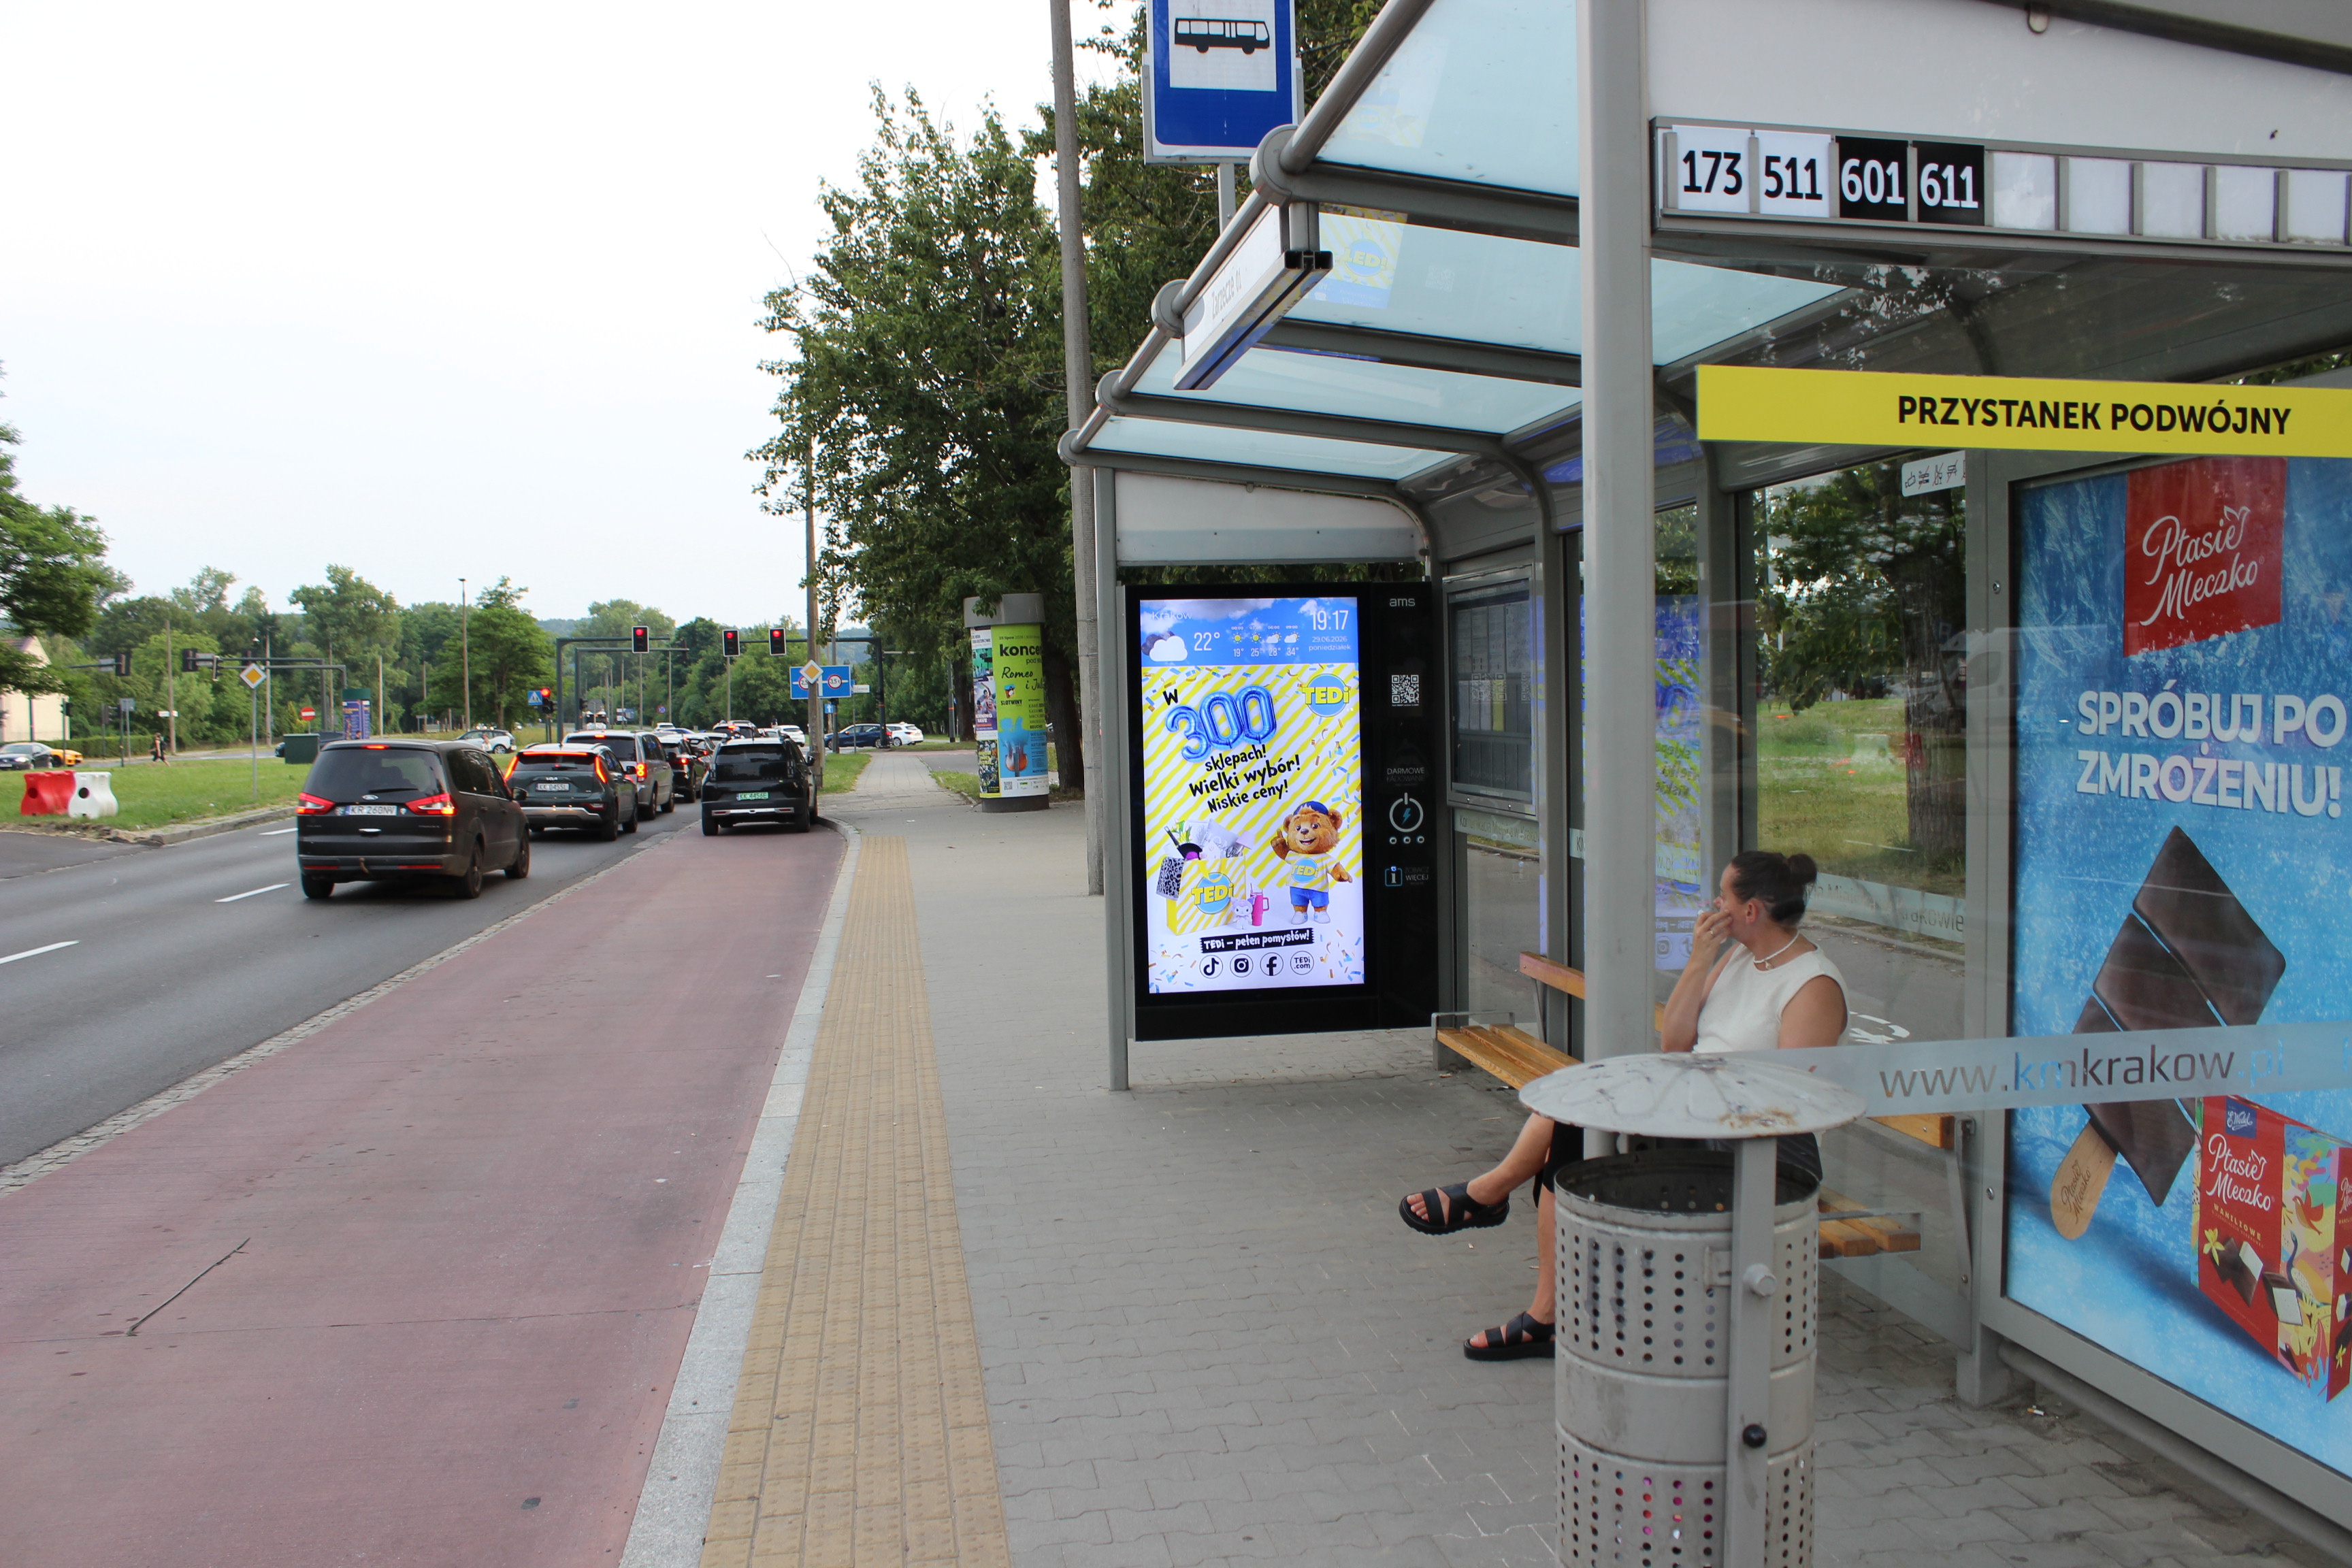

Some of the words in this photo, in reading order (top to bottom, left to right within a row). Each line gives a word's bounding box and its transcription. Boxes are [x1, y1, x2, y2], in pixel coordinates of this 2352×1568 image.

[1682, 150, 1742, 195] 173
[1764, 155, 1823, 200] 511
[1841, 158, 1905, 204] 601
[1920, 163, 1978, 208] 611
[1211, 275, 1235, 320] Zarzecze
[1235, 267, 1242, 293] 01
[1898, 396, 2101, 429] PRZYSTANEK
[2111, 399, 2291, 434] PODWÓJNY
[2142, 506, 2251, 585] Ptasie
[1389, 598, 1416, 606] ams
[2140, 553, 2258, 626] Mleczko
[1310, 610, 1349, 630] 19:17
[1194, 632, 1220, 651] 22°
[1233, 648, 1245, 657] 19°
[1250, 648, 1263, 657] 25°
[1269, 647, 1281, 656] 28°
[1286, 647, 1299, 656] 34°
[1309, 644, 1351, 652] poniedziałek
[1001, 666, 1034, 679] Romeo
[1302, 687, 1350, 705] TEDi
[2077, 680, 2263, 743] SPRÓBUJ
[2273, 693, 2347, 748] PO
[1165, 685, 1277, 763] 300
[1189, 772, 1240, 797] Wielki
[1244, 754, 1301, 786] wybór!
[1205, 745, 1267, 772] sklepach!
[1207, 792, 1250, 813] Niskie
[1253, 780, 1289, 799] ceny!
[2076, 742, 2341, 817] ZMROŻENIU!
[350, 806, 363, 815] KR
[1291, 865, 1319, 878] TEDi
[1192, 883, 1234, 905] TEDi
[1204, 938, 1224, 950] TEDi
[1235, 934, 1260, 950] pełen
[1262, 930, 1309, 947] pomysłów!
[1879, 1038, 2284, 1098] www.kmkrakow.pl
[2208, 1133, 2267, 1181] Ptasie
[2061, 1159, 2082, 1212] Ptasie
[2073, 1169, 2091, 1224] Mleczko
[2206, 1171, 2271, 1211] Mleczko
[2213, 1203, 2261, 1241] WANILIOWE
